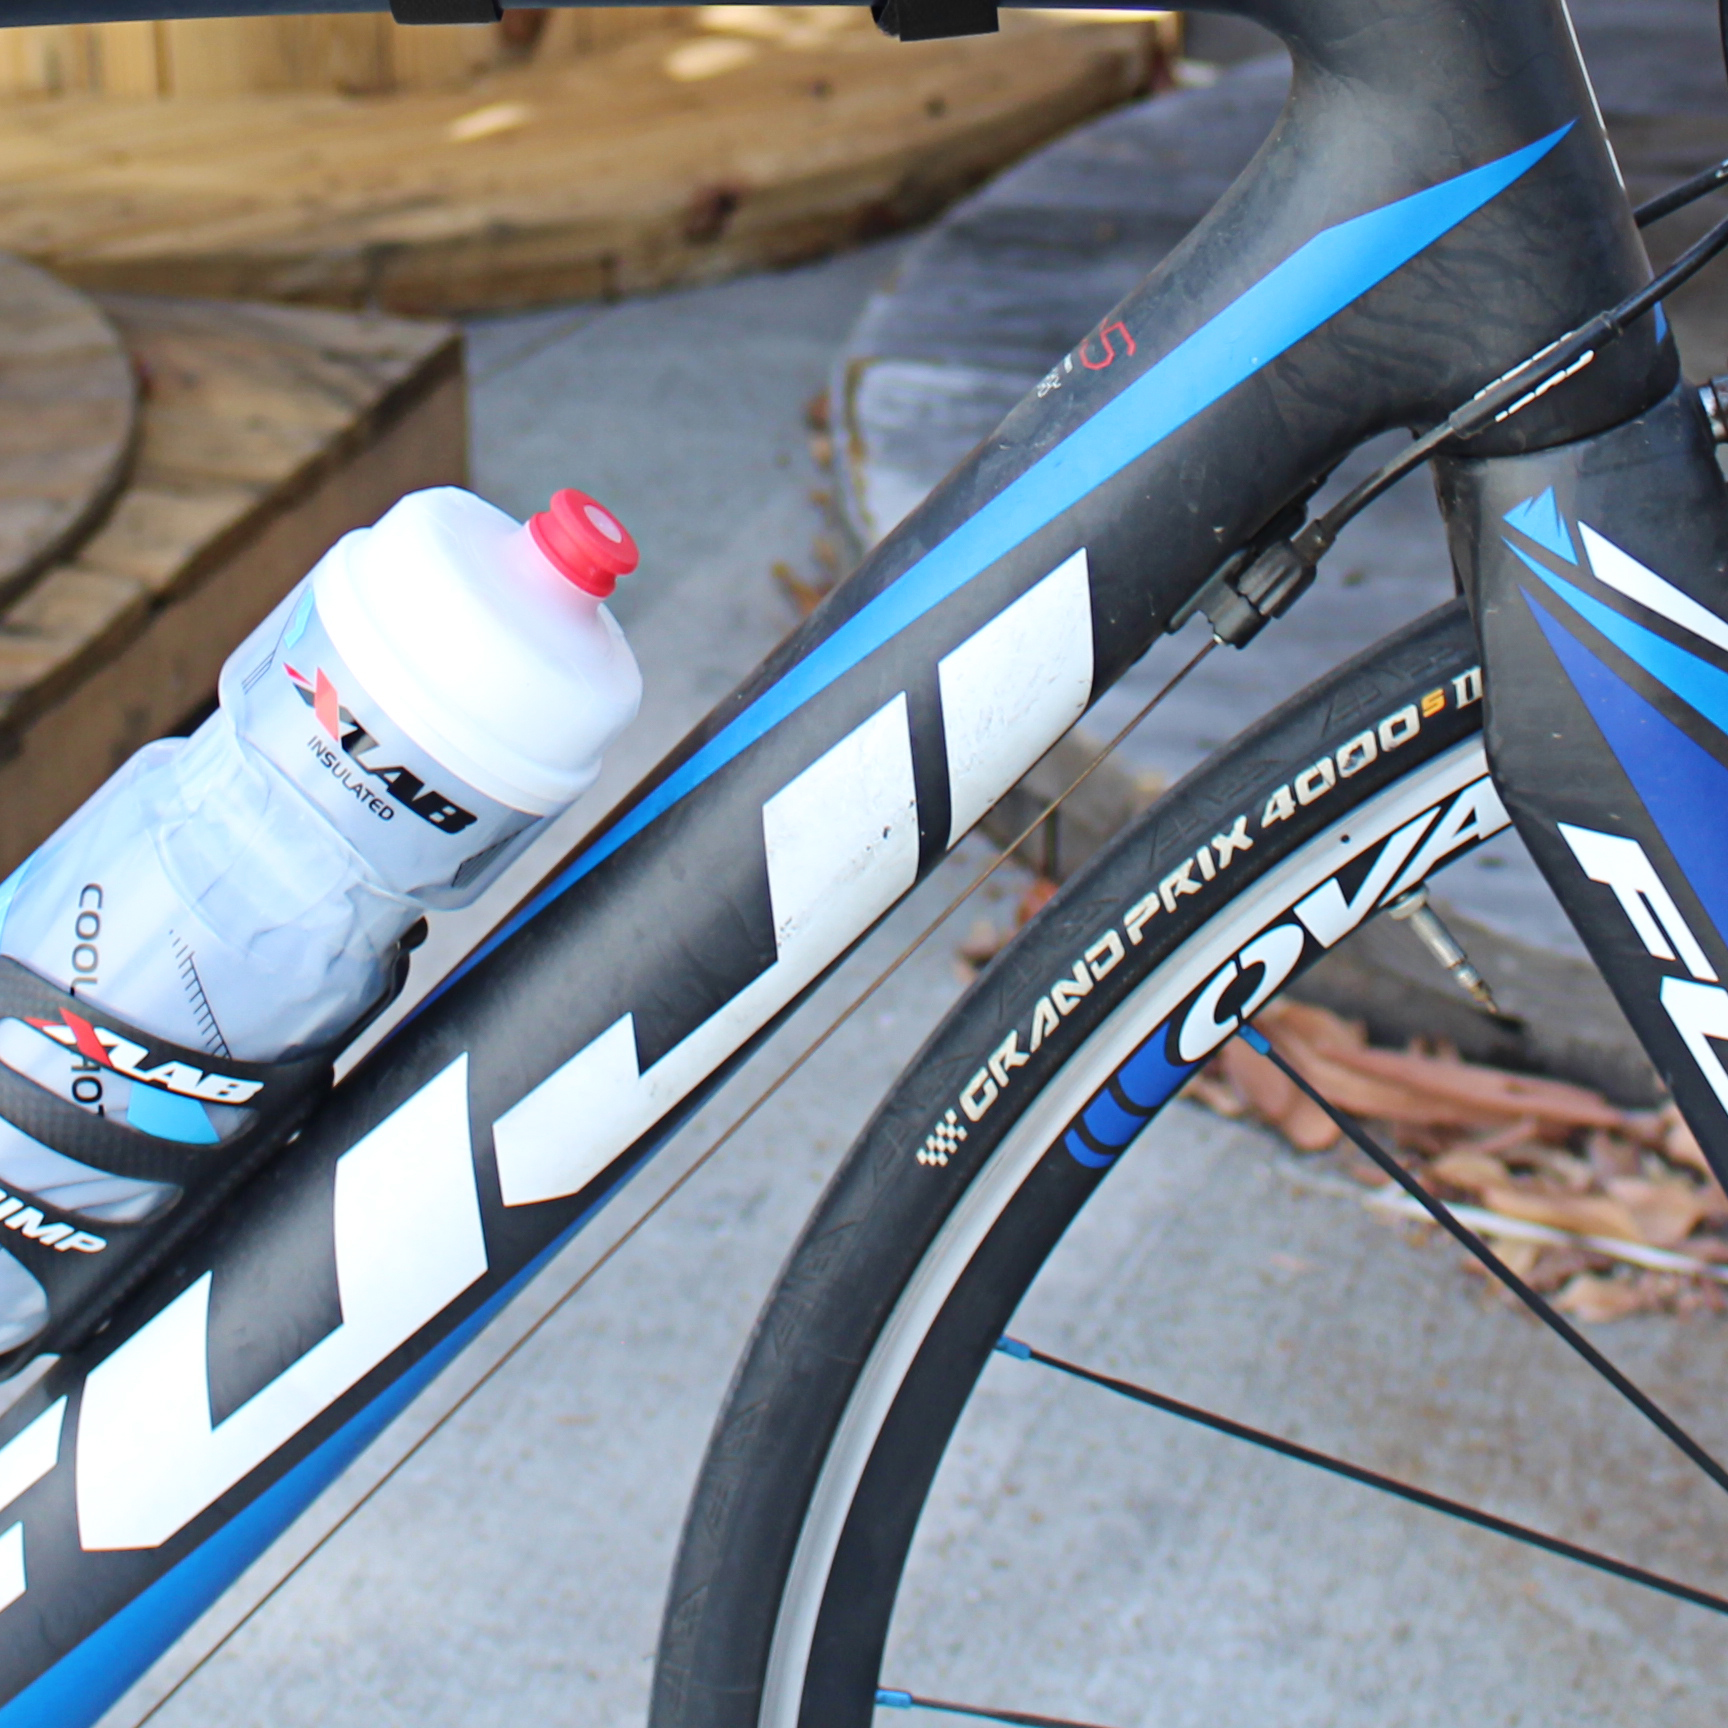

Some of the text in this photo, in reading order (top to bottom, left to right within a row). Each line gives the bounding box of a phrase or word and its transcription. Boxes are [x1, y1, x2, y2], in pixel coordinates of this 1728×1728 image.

[282, 661, 478, 834] XLAB
[306, 734, 396, 822] INSULATED
[70, 882, 104, 997] COOL
[958, 928, 1125, 1122] GRAND
[1122, 814, 1254, 946] PRIX
[1178, 774, 1513, 1063] OVA
[24, 1006, 265, 1105] XLAB
